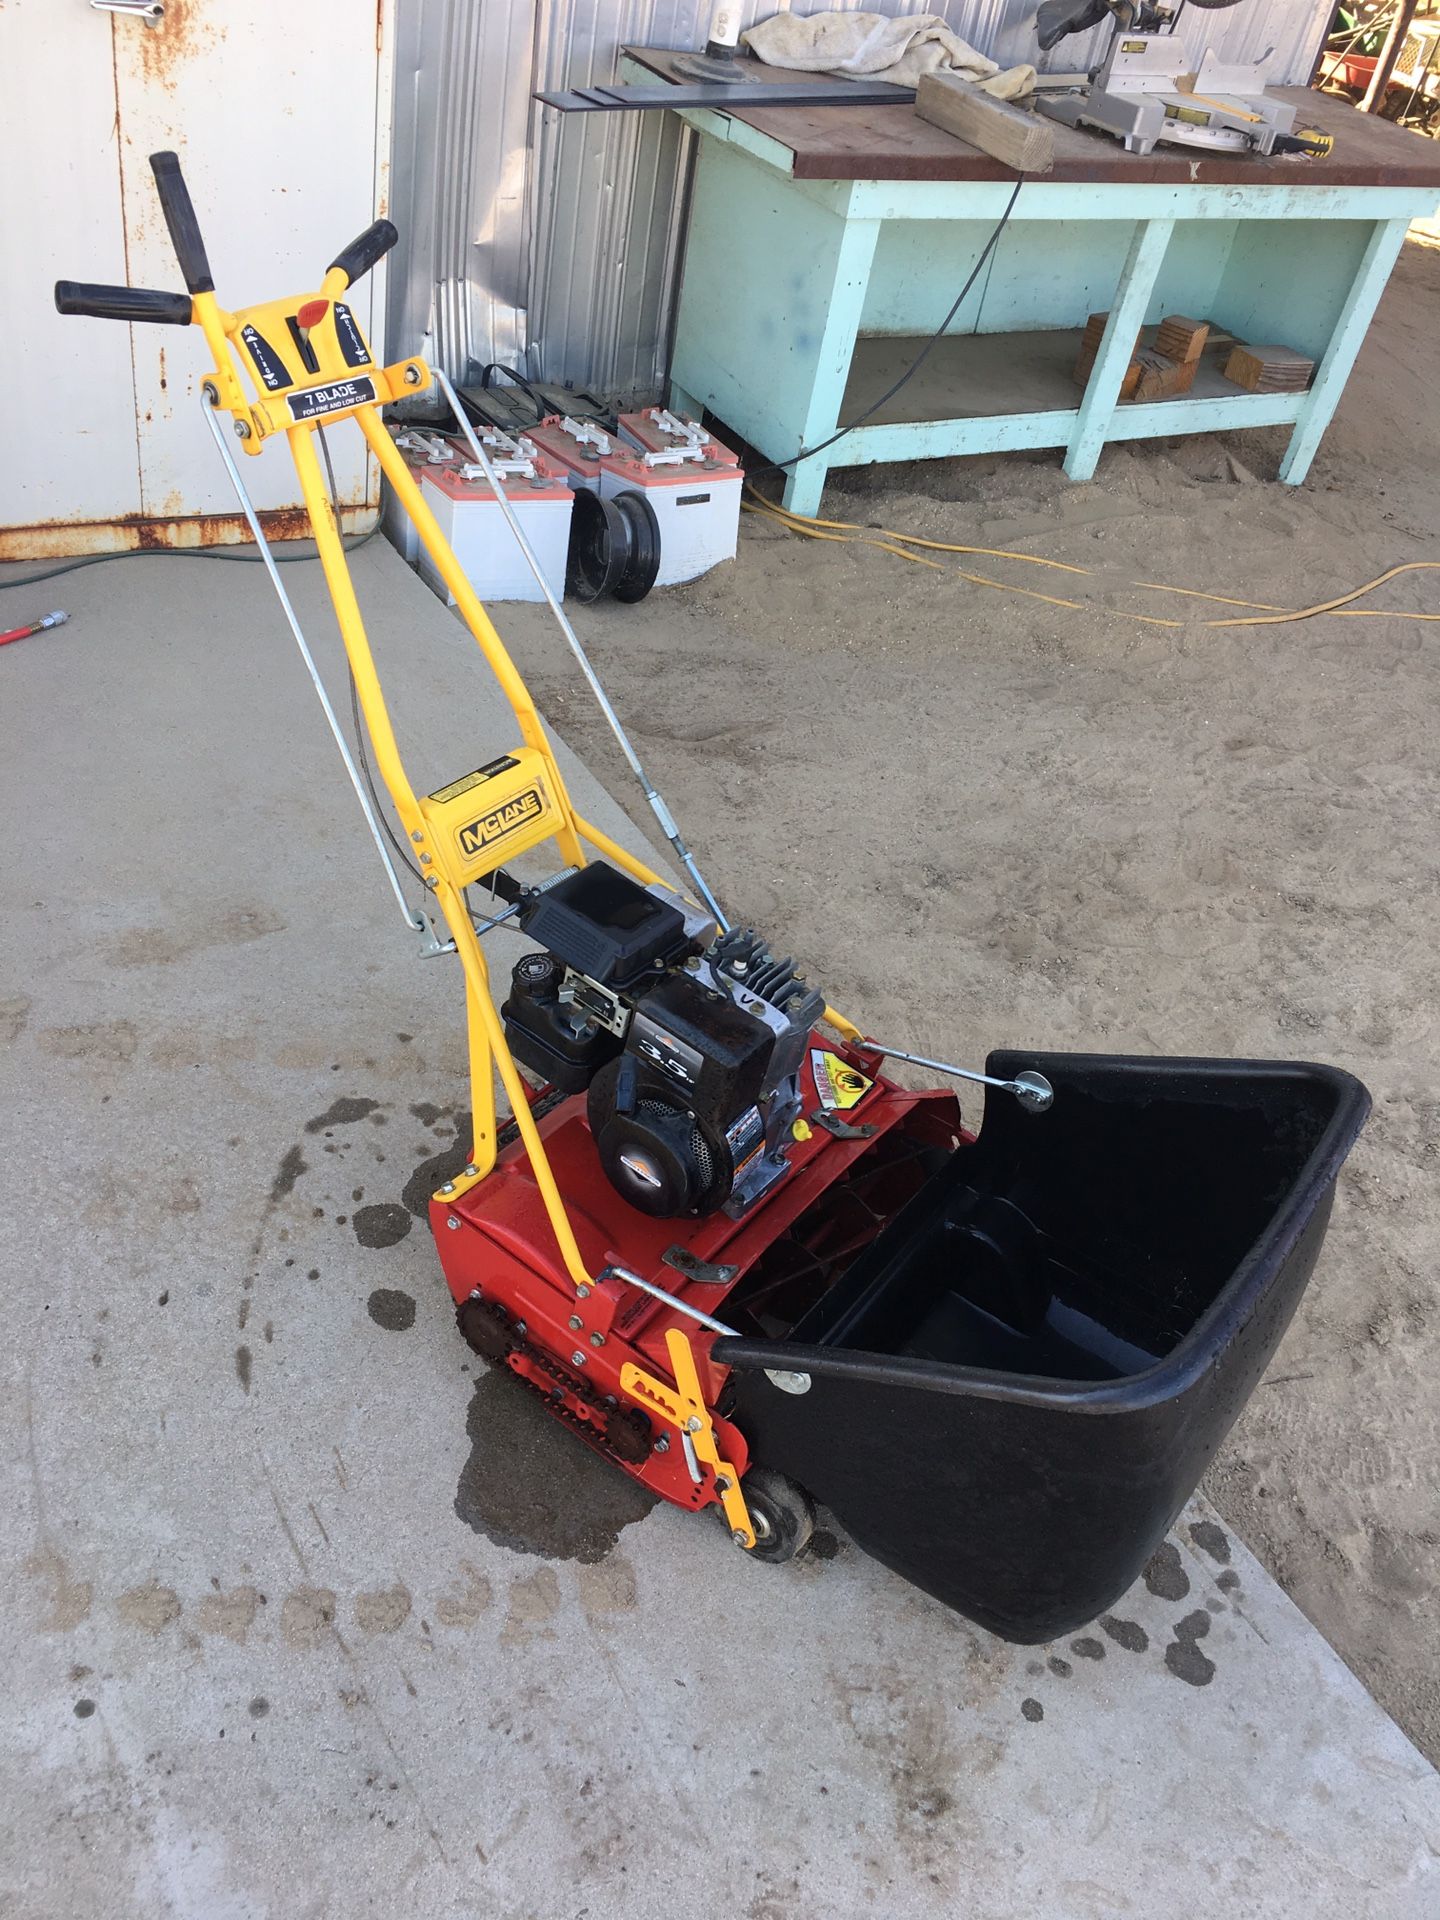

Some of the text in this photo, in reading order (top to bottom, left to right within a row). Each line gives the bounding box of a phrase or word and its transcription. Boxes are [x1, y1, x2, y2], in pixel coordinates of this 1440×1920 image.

[302, 394, 367, 417] FOR FINE AND LOW CUT
[305, 383, 357, 406] 7 BLADE
[815, 1063, 833, 1100] DANGER
